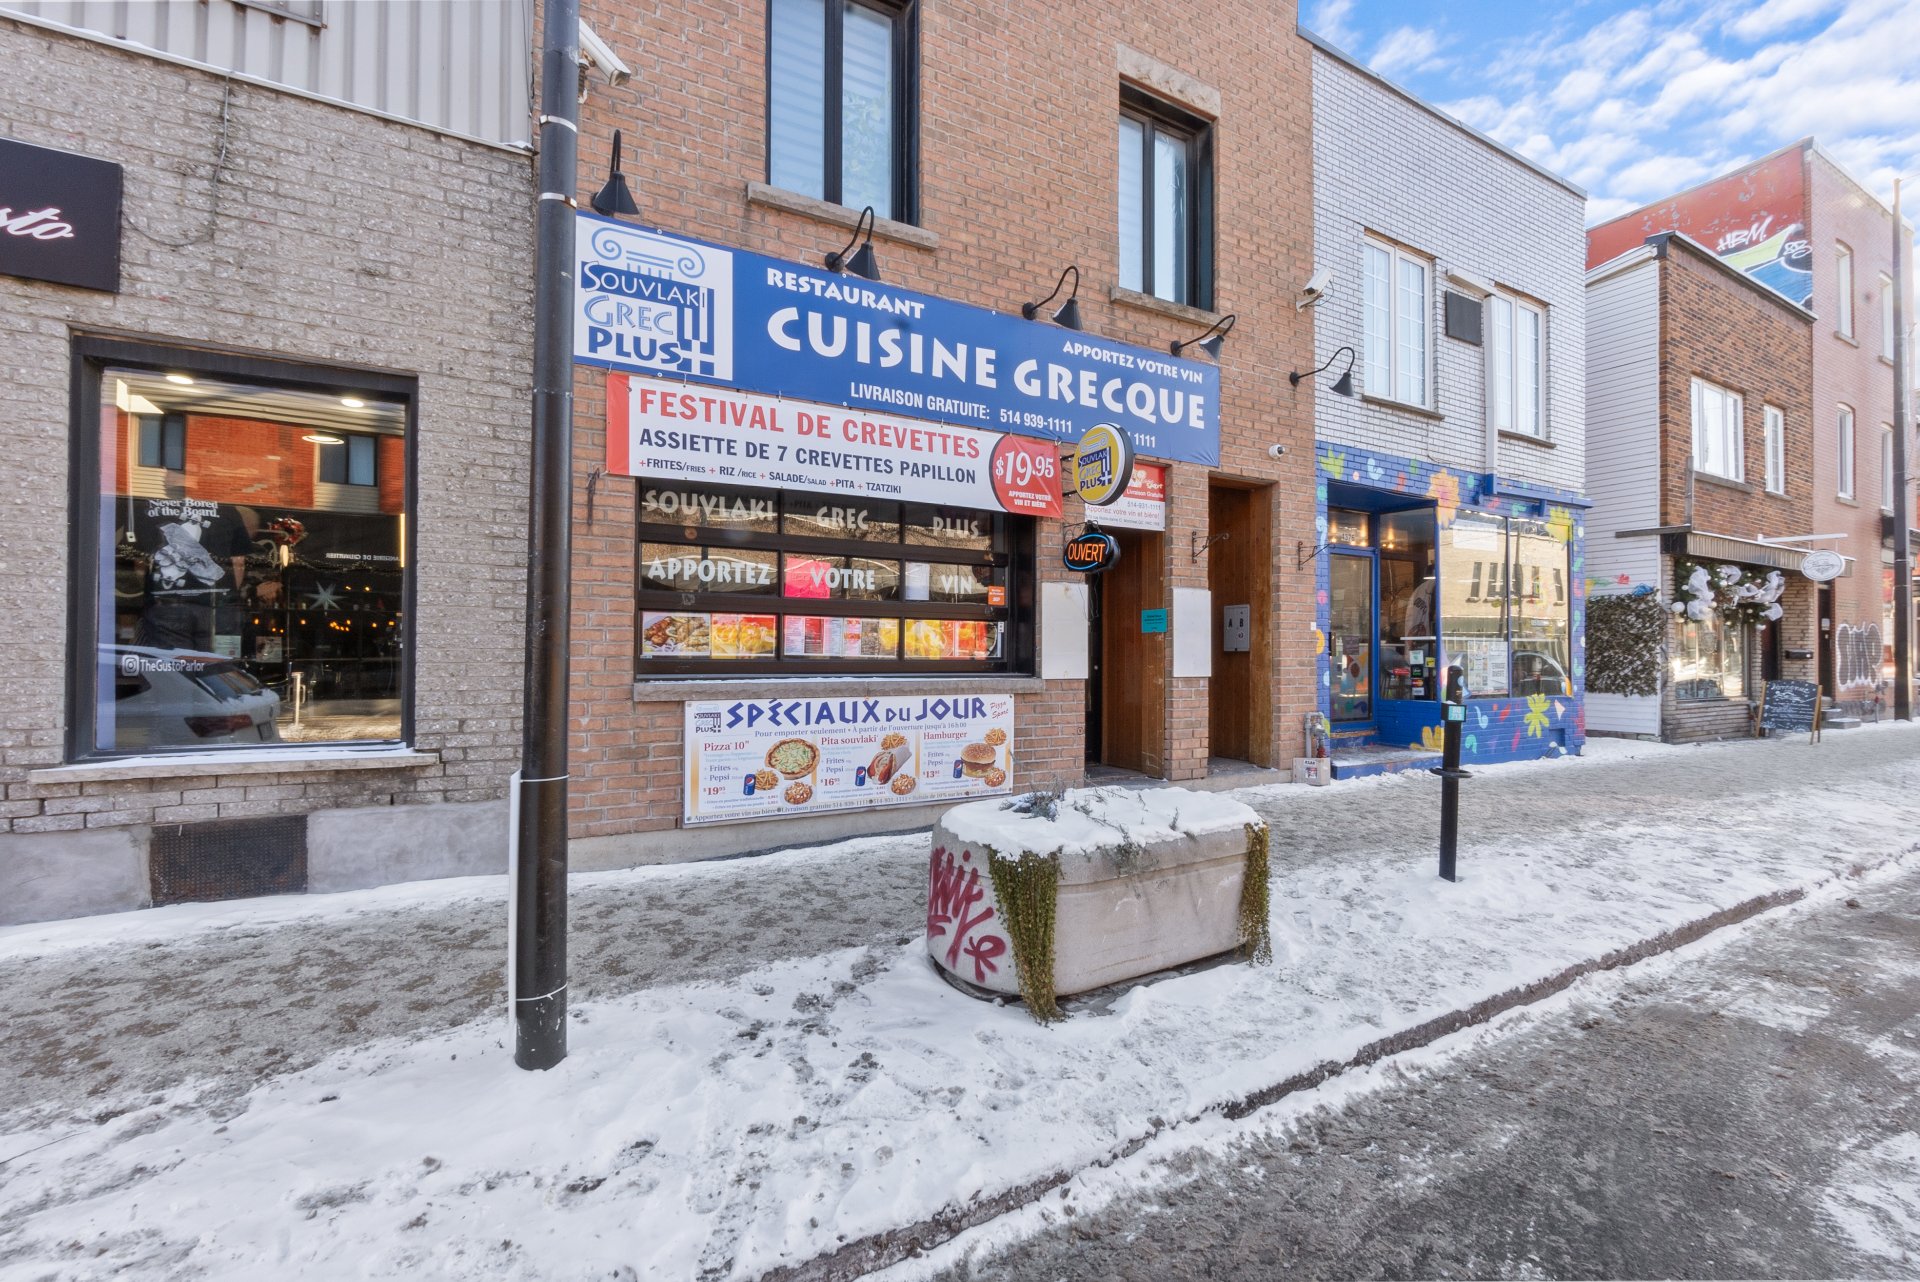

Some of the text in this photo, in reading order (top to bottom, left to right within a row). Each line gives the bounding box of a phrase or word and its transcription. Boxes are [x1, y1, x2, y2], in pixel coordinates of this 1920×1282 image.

[583, 260, 706, 308] SOUVLAKI
[767, 267, 925, 319] RESTAURANT
[583, 294, 674, 336] GREC
[588, 325, 683, 365] PLUS
[767, 306, 1205, 430] CUISINE GRECQUE
[1062, 340, 1203, 384] APPORTEZ VOTRE VIN
[850, 381, 923, 408] LIVRAISON
[926, 395, 990, 420] GRATUITE:
[1000, 408, 1021, 424] 514
[1023, 411, 1072, 434] 939-1111
[640, 388, 980, 459] FESTIVAL DE CREVETTES
[639, 428, 976, 484] ASSIETTE DE 7 CREVETTES PAPILLON
[719, 465, 736, 476] RIZ
[865, 482, 902, 494] TZATZIKI
[148, 507, 161, 518] of
[162, 507, 180, 516] the
[149, 499, 218, 509] Never Bored
[645, 490, 774, 521] SOUVLAKI
[816, 505, 869, 531] GREC
[932, 516, 979, 539] PLUS
[1068, 543, 1105, 563] OUVERT
[647, 556, 771, 585] APPORTEZ
[810, 566, 875, 590] VOTRE
[941, 574, 974, 595] VIN
[139, 659, 205, 672] TheGustoParlor
[726, 696, 988, 729] SPÉCIAUX DU JOUR
[754, 730, 773, 738] Pour
[774, 728, 809, 738] emporter
[858, 725, 878, 734] partir
[879, 724, 888, 732] de
[820, 736, 839, 745] Pita
[923, 731, 968, 741] Hamburger
[825, 766, 844, 775] Pepsi
[927, 759, 944, 767] Pepsi
[709, 773, 730, 783] Pepsi
[693, 811, 723, 823] Apportez
[724, 810, 741, 819] votre
[741, 809, 752, 817] vin
[761, 806, 777, 815] bière
[781, 804, 809, 813] Livraison
[809, 802, 832, 812] gratuite
